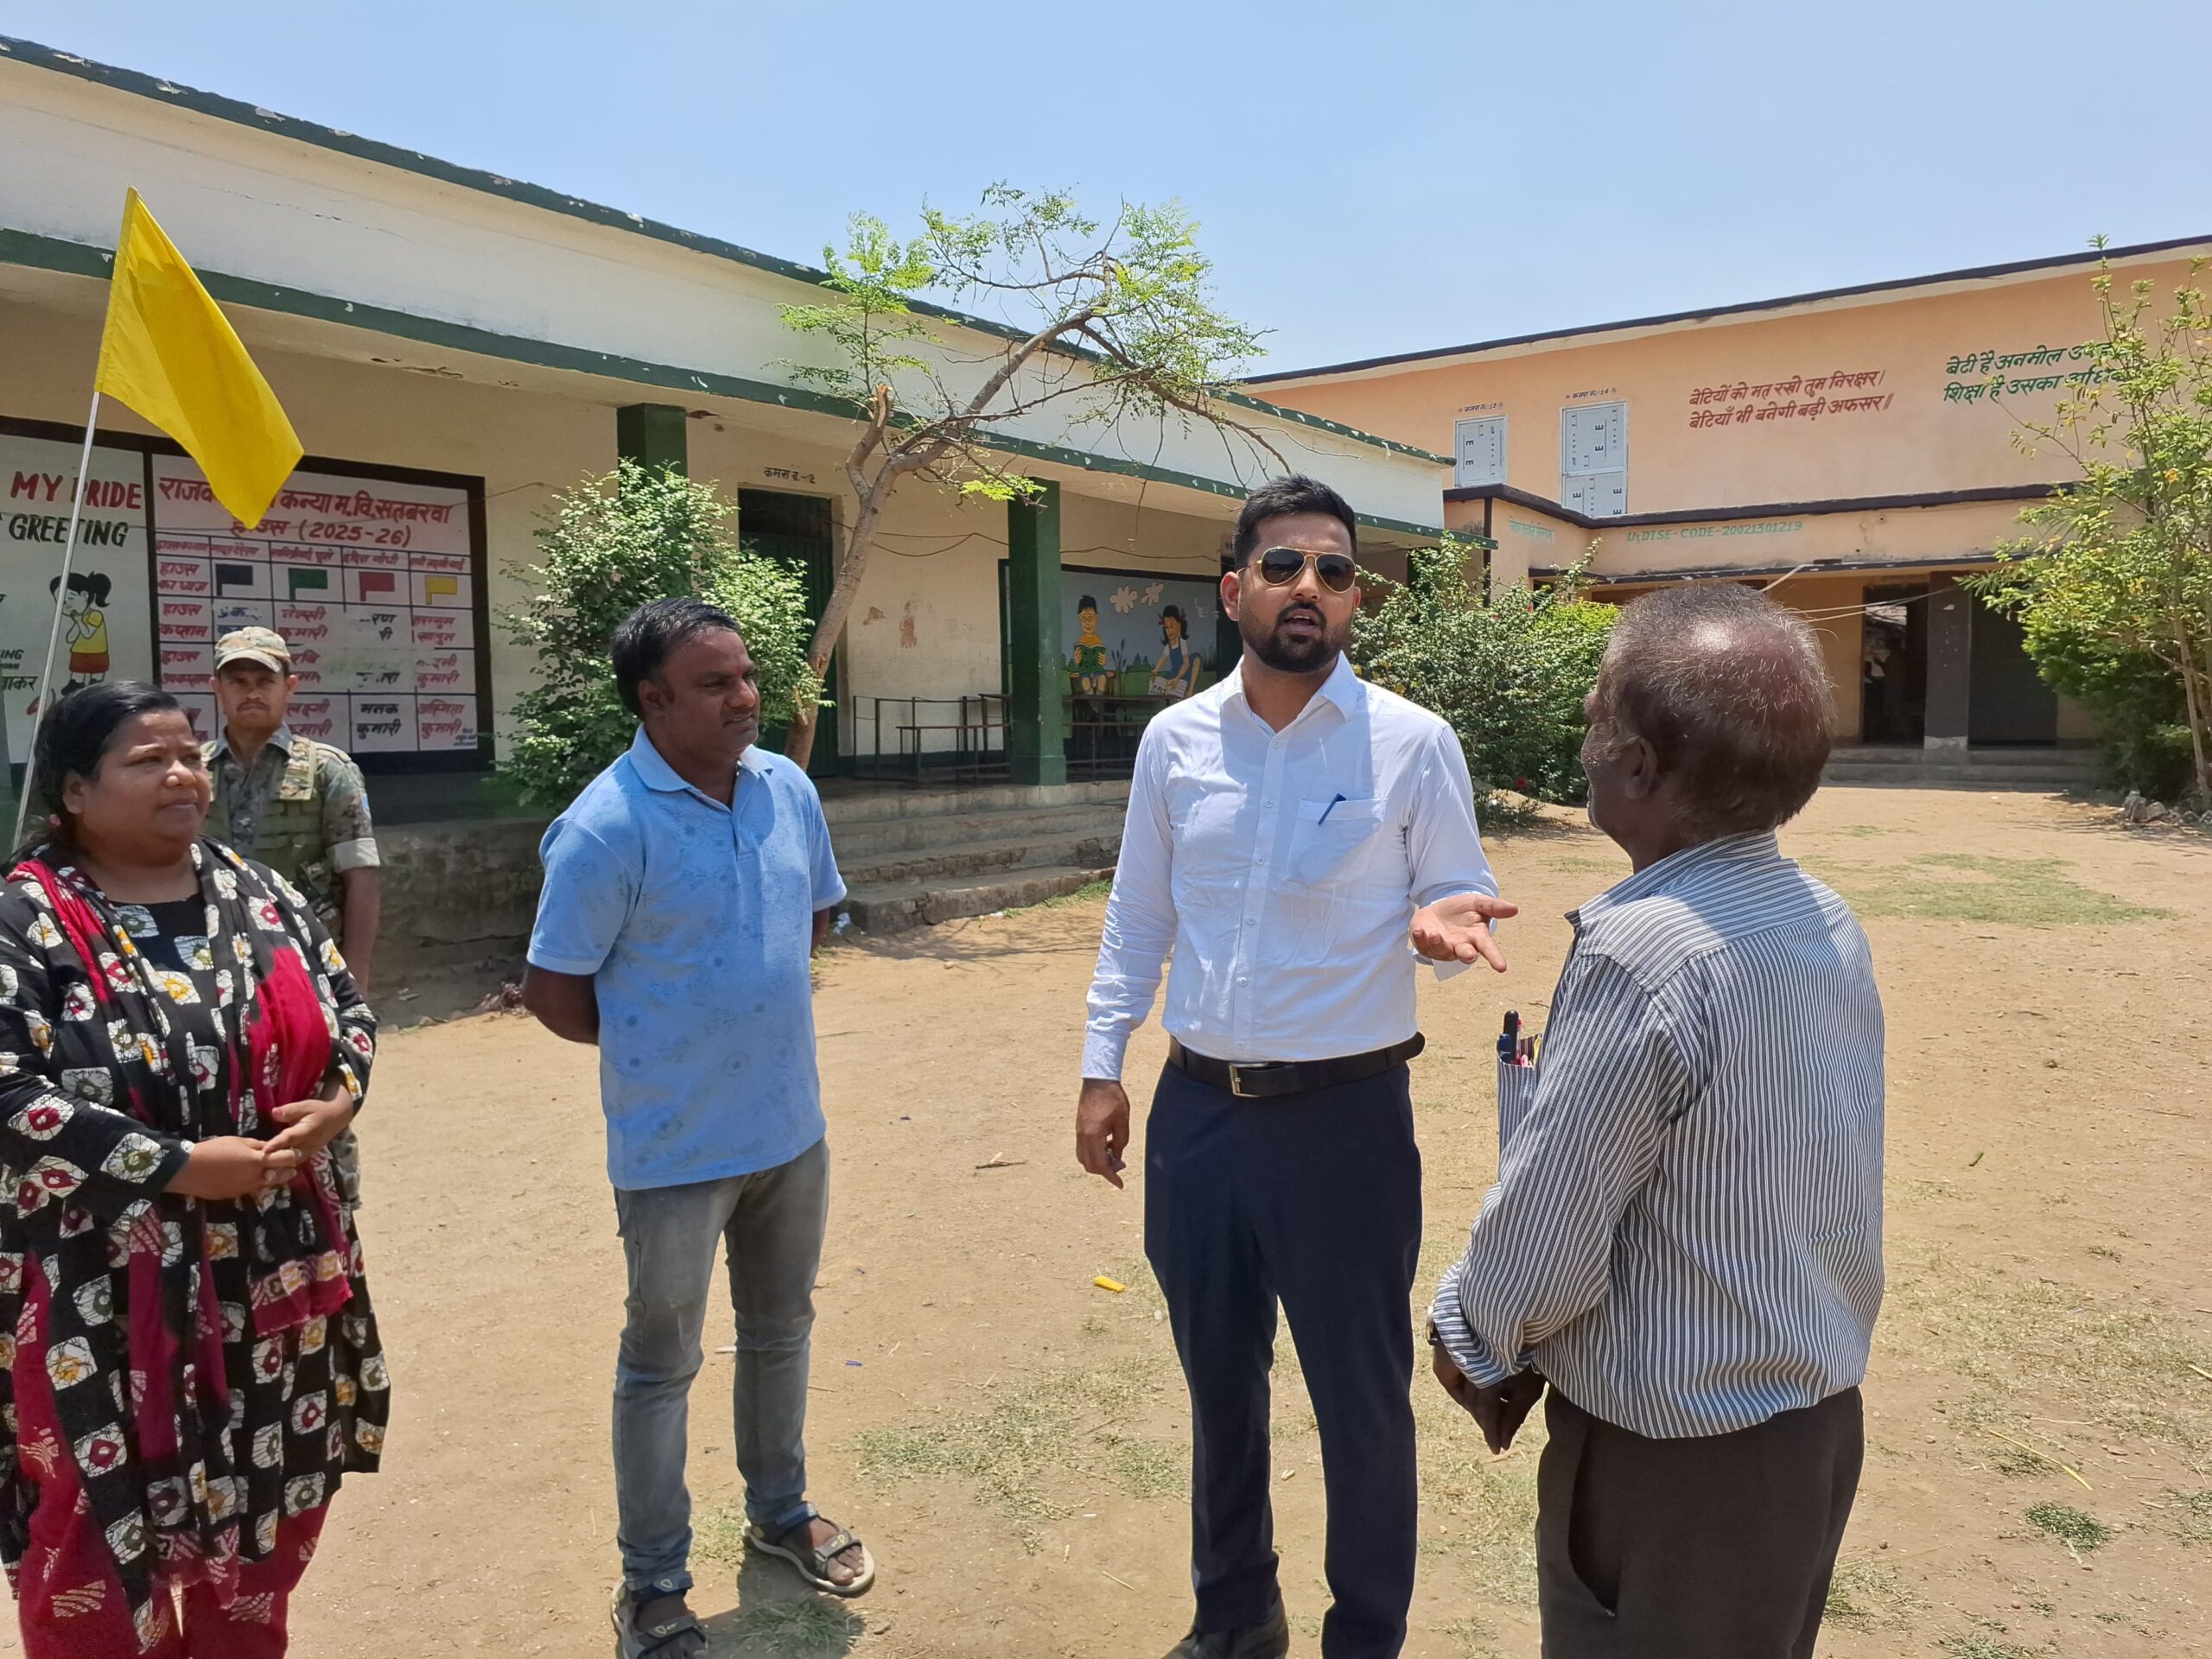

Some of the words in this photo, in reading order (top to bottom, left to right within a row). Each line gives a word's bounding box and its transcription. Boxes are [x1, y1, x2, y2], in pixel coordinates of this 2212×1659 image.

[1946, 353, 1979, 374] बेटी
[1980, 350, 1994, 374] है
[1994, 345, 2068, 370] अनमोल
[1689, 383, 1732, 405] बेटियों
[1730, 381, 1749, 400] को
[1751, 384, 1773, 400] मत
[1774, 375, 1802, 396] रखो
[1804, 376, 1828, 397] तुम
[2005, 374, 2064, 396] उसका
[1689, 404, 1735, 429] बेटियाँ
[1735, 404, 1754, 424] भी
[1755, 400, 1797, 421] बनेगी
[1797, 397, 1827, 421] बड़ी
[10, 471, 64, 502] MY
[280, 489, 334, 513] कन्या
[298, 518, 410, 548] (2025-26)
